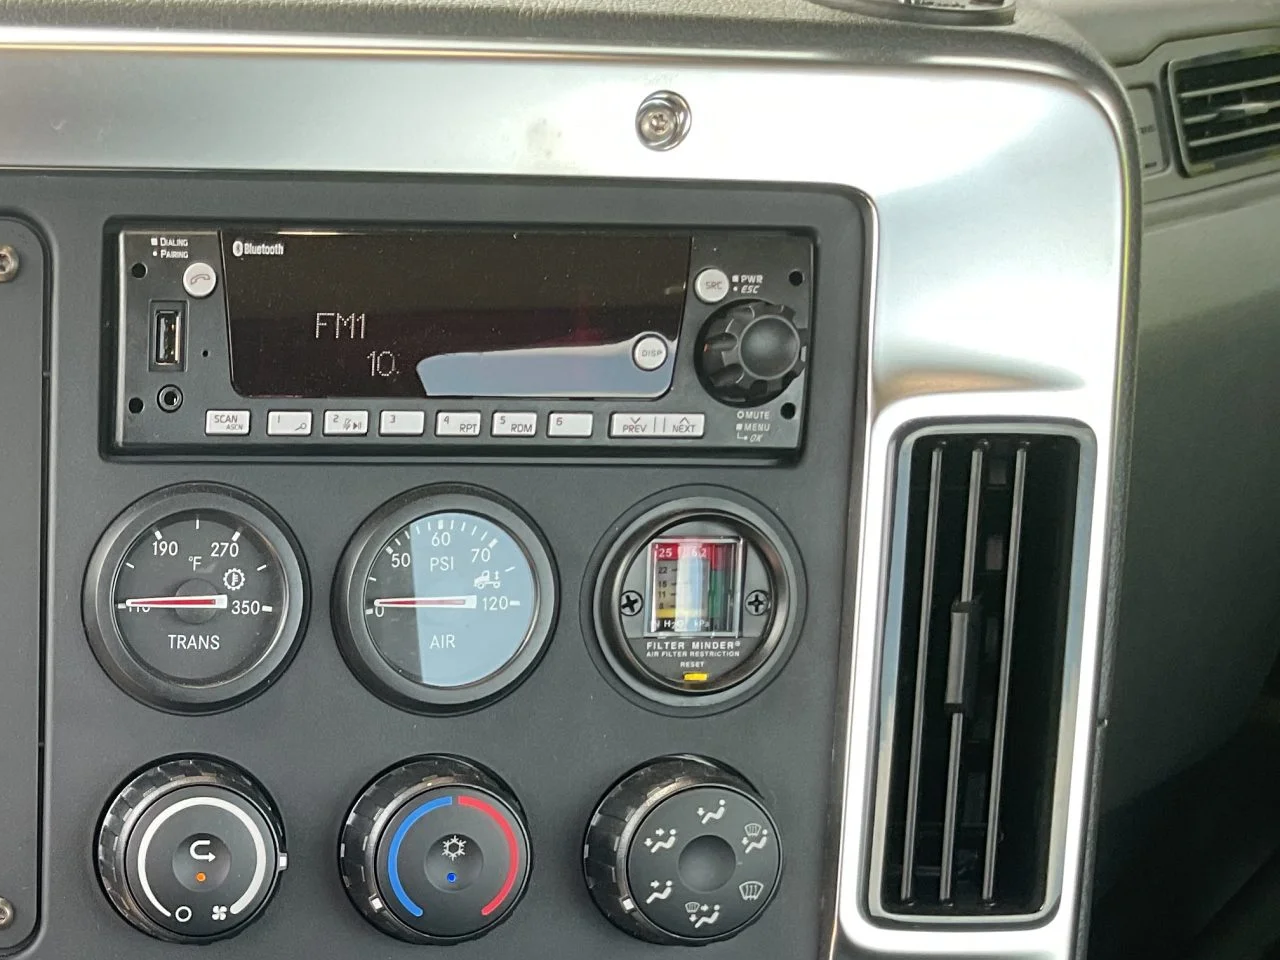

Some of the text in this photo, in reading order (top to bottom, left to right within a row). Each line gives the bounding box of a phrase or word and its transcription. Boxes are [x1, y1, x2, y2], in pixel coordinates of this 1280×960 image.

[160, 237, 189, 247] DIALING
[244, 242, 284, 255] Bluetooth
[160, 249, 189, 259] PAIRING
[740, 274, 763, 284] PWR
[705, 281, 723, 290] SRC
[740, 285, 760, 294] ESC
[315, 312, 366, 339] FM1
[214, 414, 238, 423] SCAN
[332, 414, 340, 423] 2
[389, 415, 396, 424] 3
[443, 415, 450, 425] 4
[499, 416, 506, 425] 5
[745, 411, 770, 420] MUTE
[556, 417, 563, 426] 6
[459, 423, 478, 433] RPT
[511, 423, 533, 433] RDM
[622, 424, 647, 433] PREV
[672, 424, 696, 433] NEXT
[744, 423, 771, 433] MENU
[431, 531, 451, 547] 60
[152, 541, 179, 556] 190
[210, 542, 239, 557] 270
[659, 547, 672, 558] 25
[391, 552, 411, 568] 50
[471, 547, 491, 563] 70
[430, 556, 455, 572] PSI
[231, 600, 260, 615] 350
[482, 596, 508, 611] 120
[168, 634, 220, 650] TRANS
[429, 634, 456, 649] AIR
[646, 641, 685, 650] FILTER
